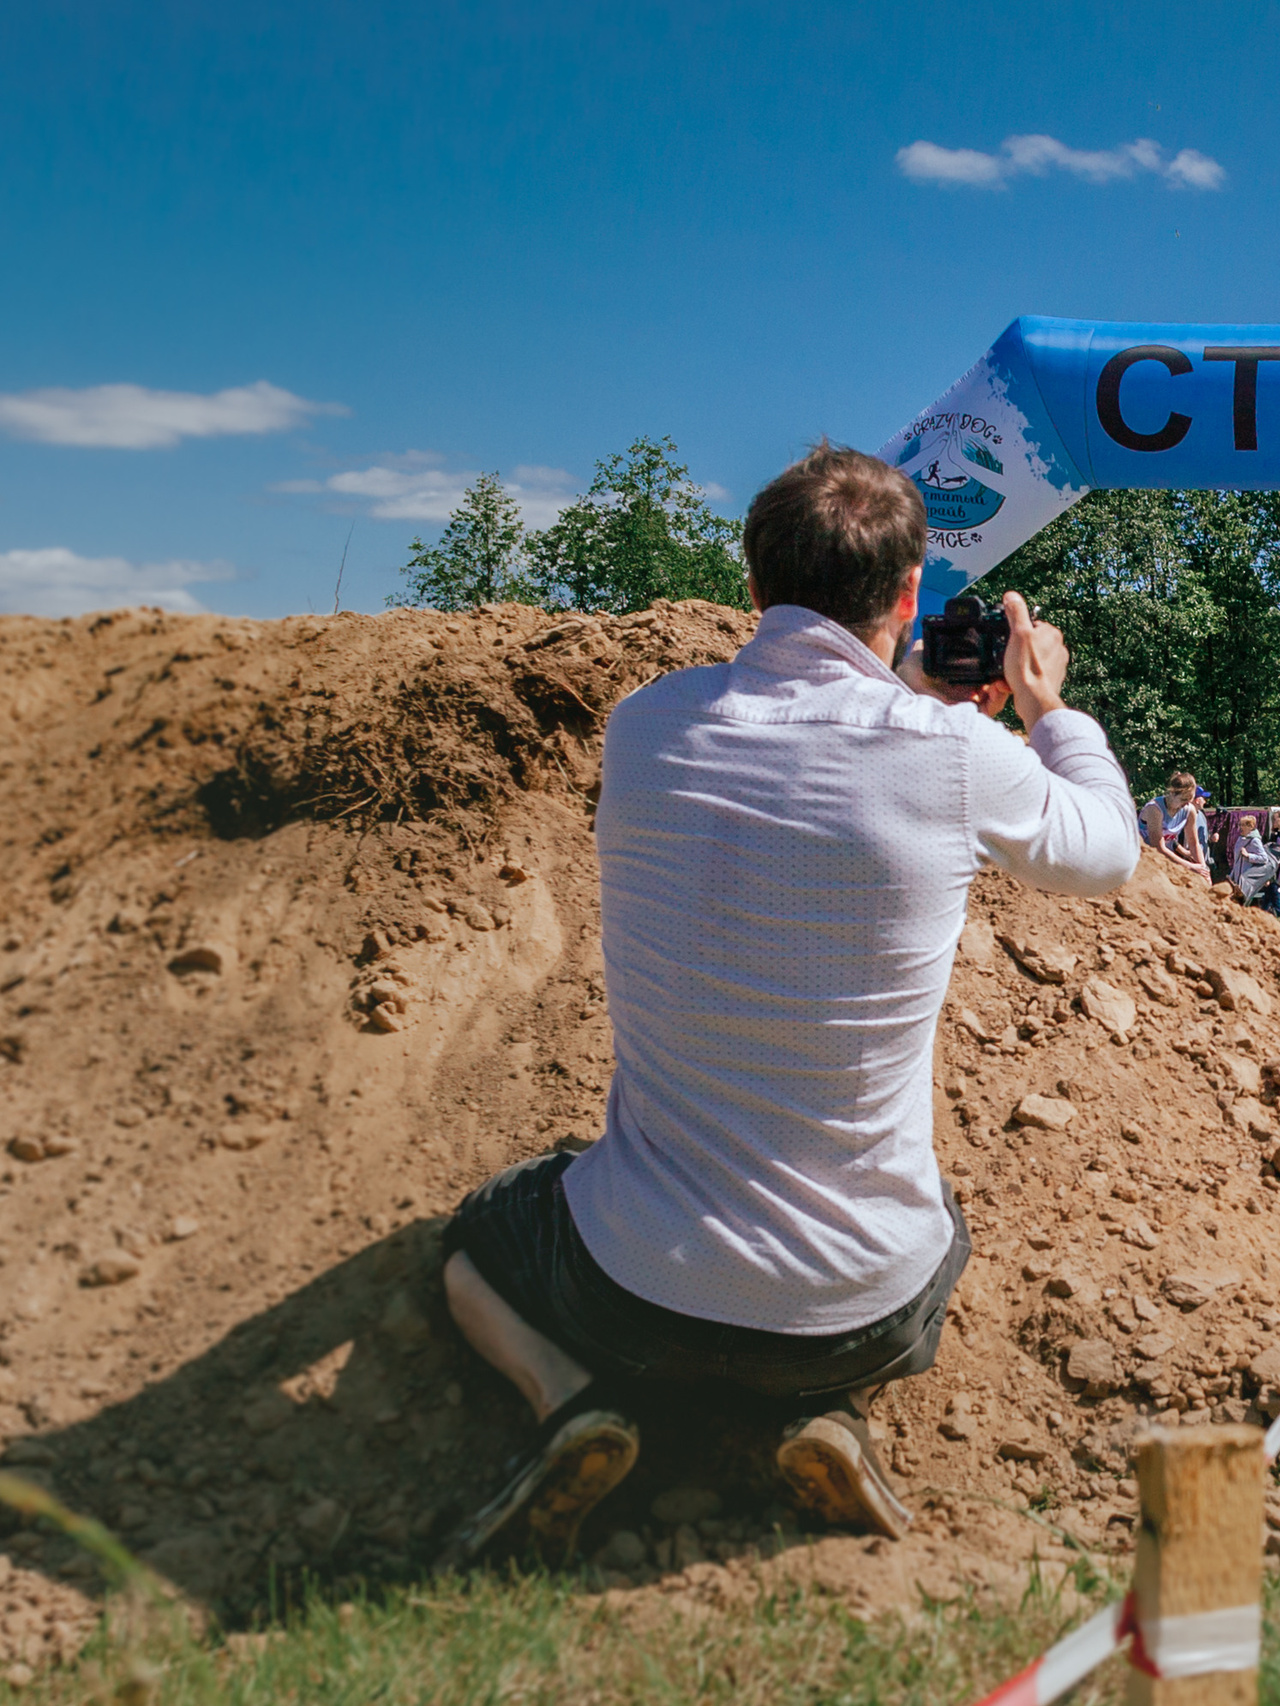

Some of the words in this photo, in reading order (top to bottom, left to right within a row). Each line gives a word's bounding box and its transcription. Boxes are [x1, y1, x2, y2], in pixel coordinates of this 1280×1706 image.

[913, 412, 954, 436] CRAZY
[960, 413, 996, 438] DOG
[923, 489, 987, 505] статый
